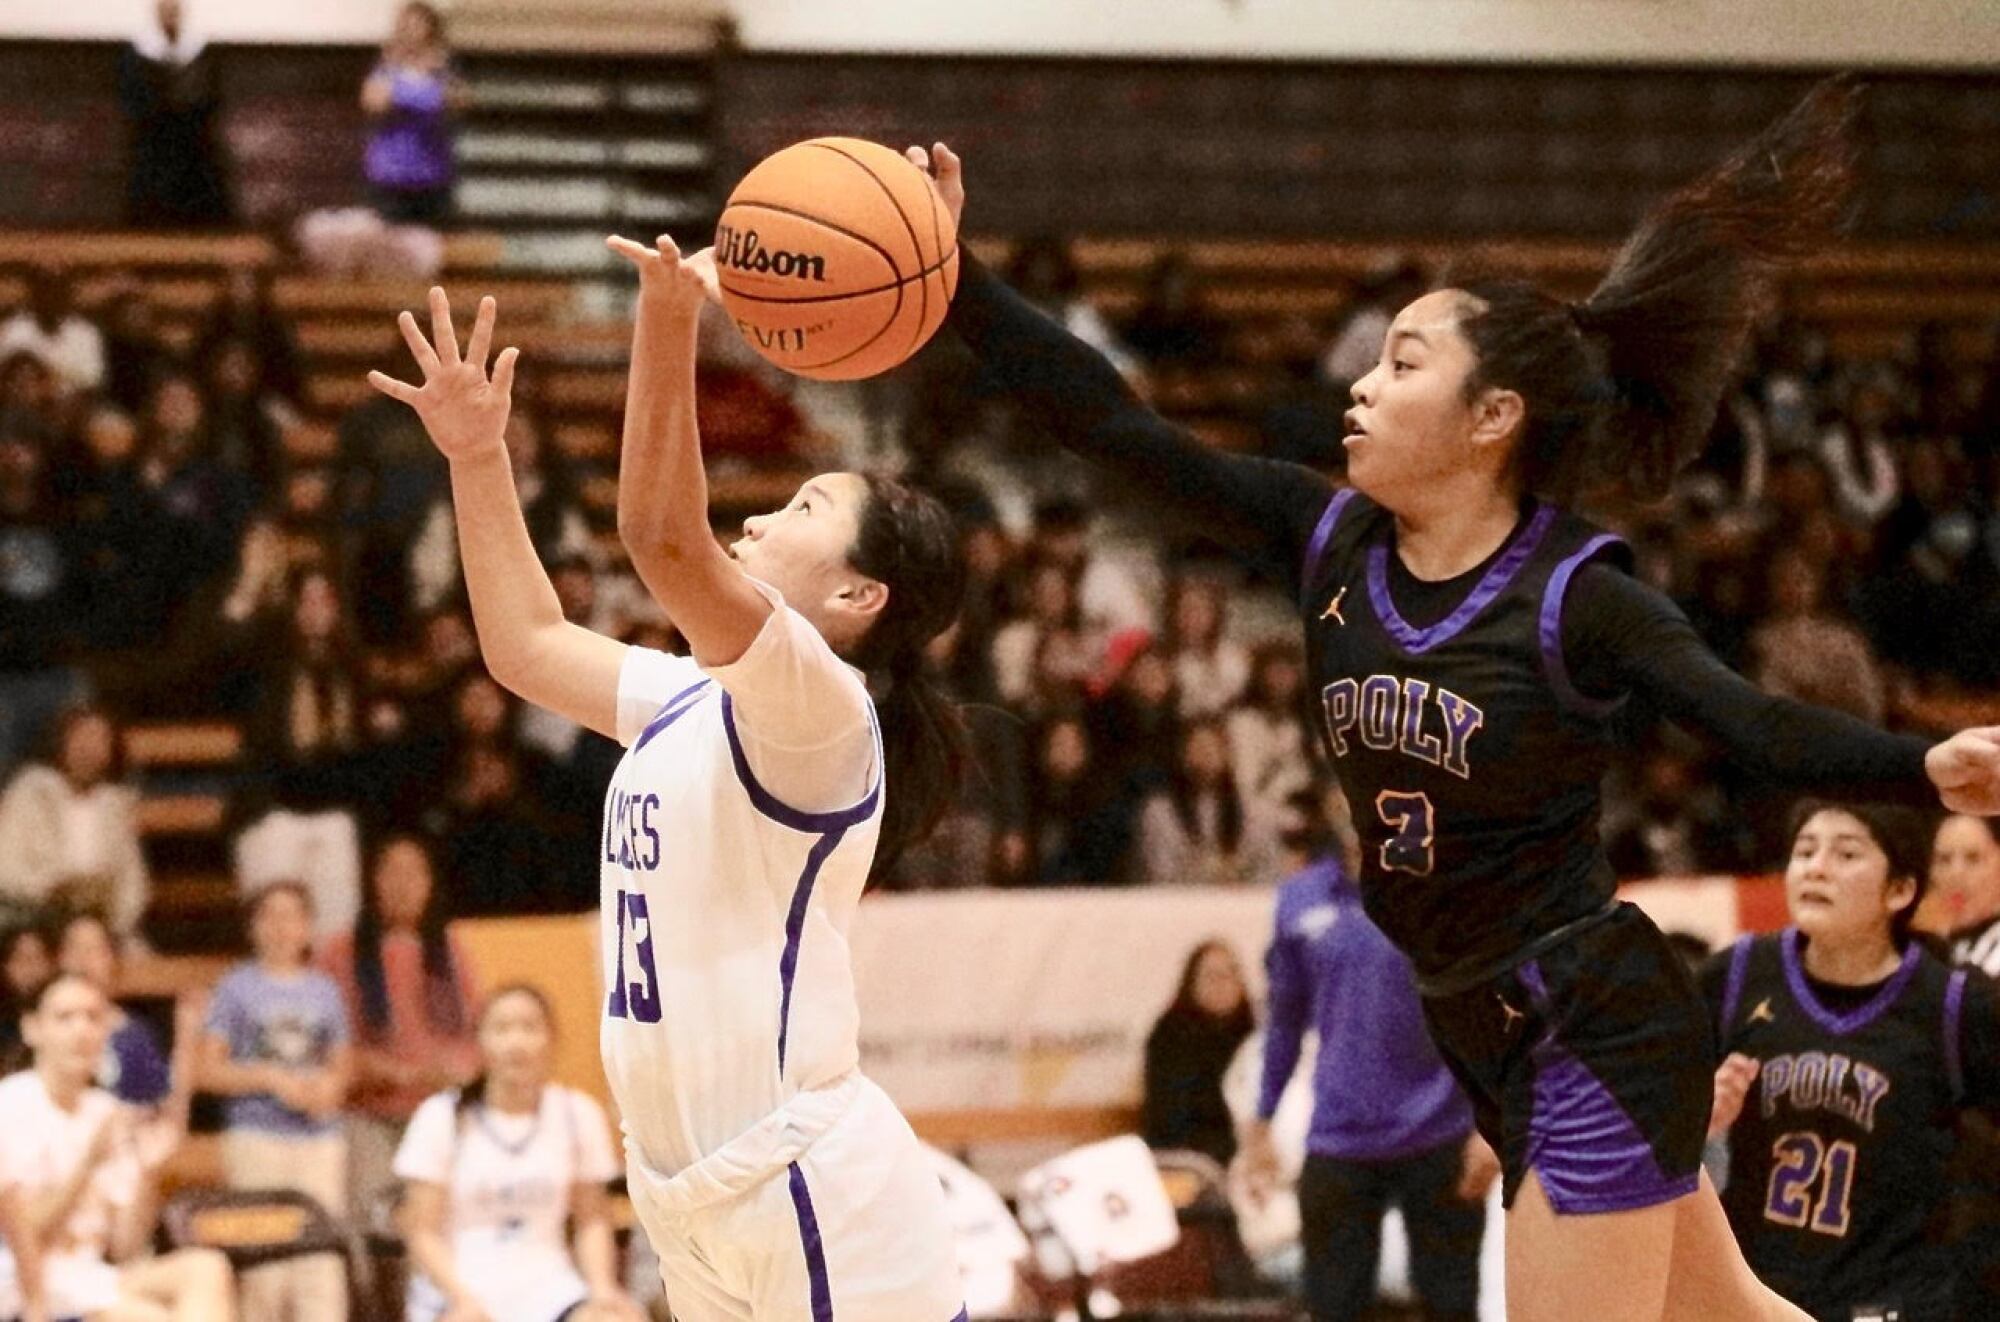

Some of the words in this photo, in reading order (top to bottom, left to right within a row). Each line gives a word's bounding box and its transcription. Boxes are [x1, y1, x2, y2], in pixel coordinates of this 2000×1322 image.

[1322, 674, 1484, 780] POLY
[608, 889, 663, 1024] 13
[1761, 1051, 1890, 1135] POLY
[1763, 1130, 1856, 1237] 21
